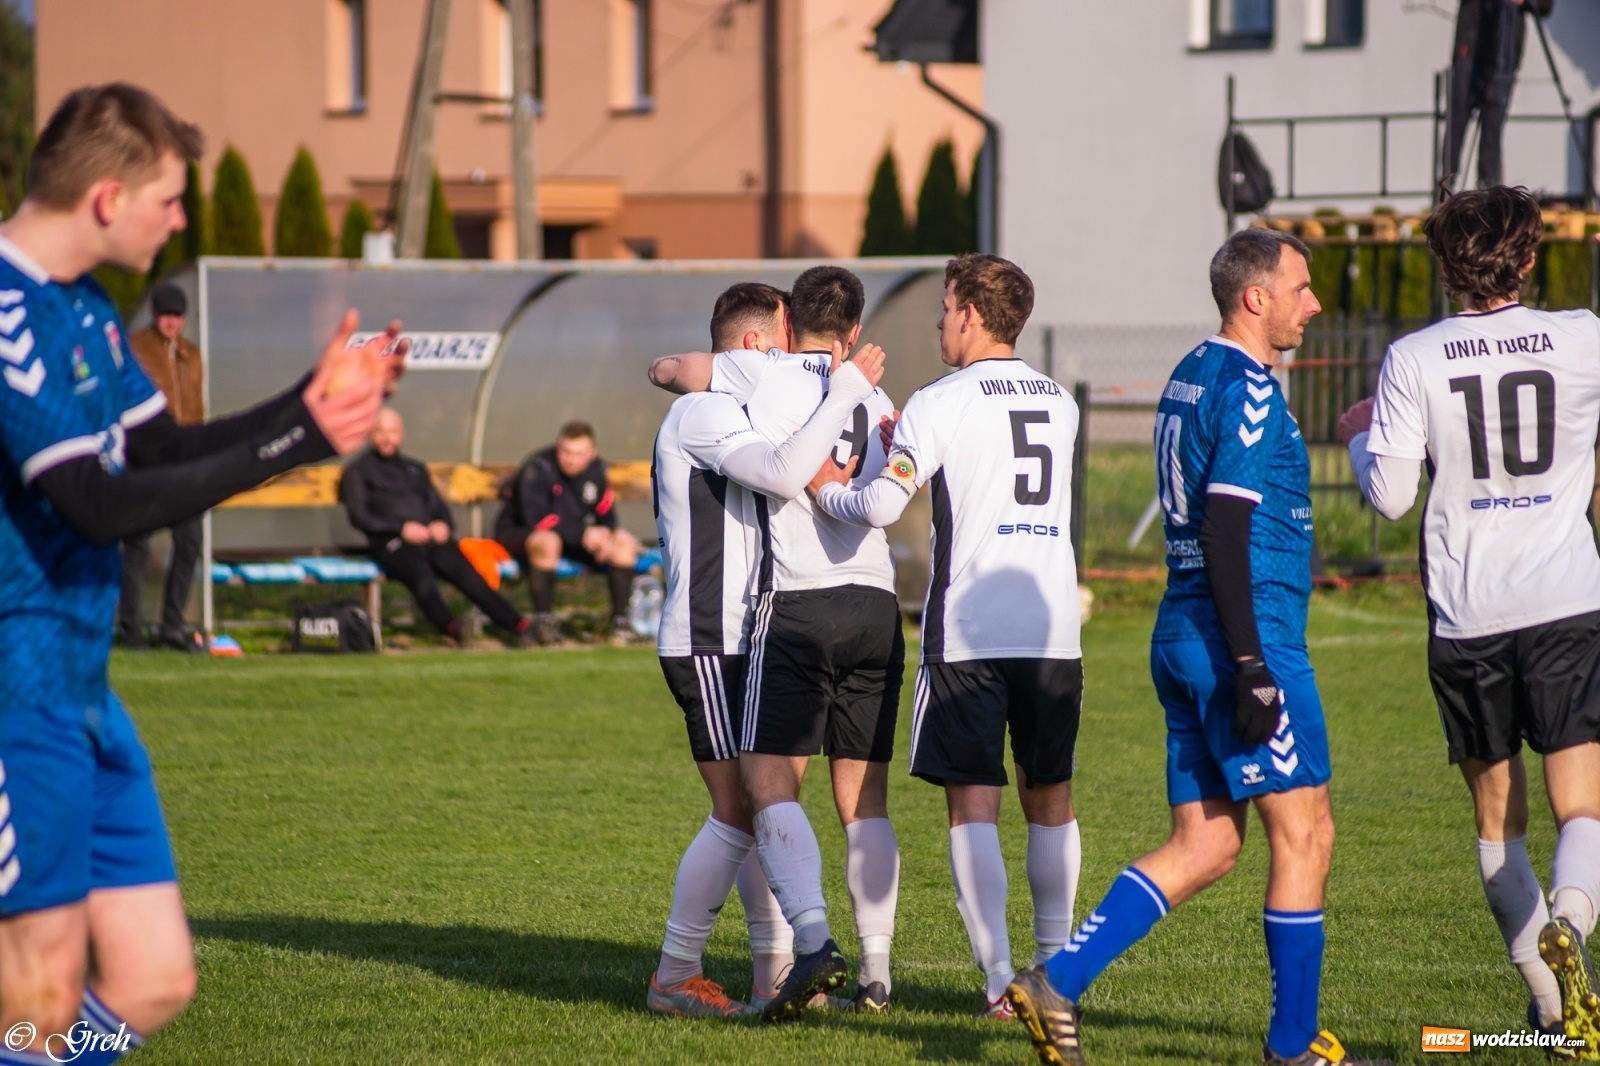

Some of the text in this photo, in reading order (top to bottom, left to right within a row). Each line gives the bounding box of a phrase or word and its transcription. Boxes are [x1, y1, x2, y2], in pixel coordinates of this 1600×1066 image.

[1443, 332, 1555, 360] UNIA TURZA
[802, 359, 831, 378] UNI
[979, 379, 1063, 398] UNIA TURZA
[1448, 369, 1557, 480] 10
[1008, 410, 1053, 506] 5
[1470, 494, 1553, 511] GROS
[997, 523, 1060, 538] GROS
